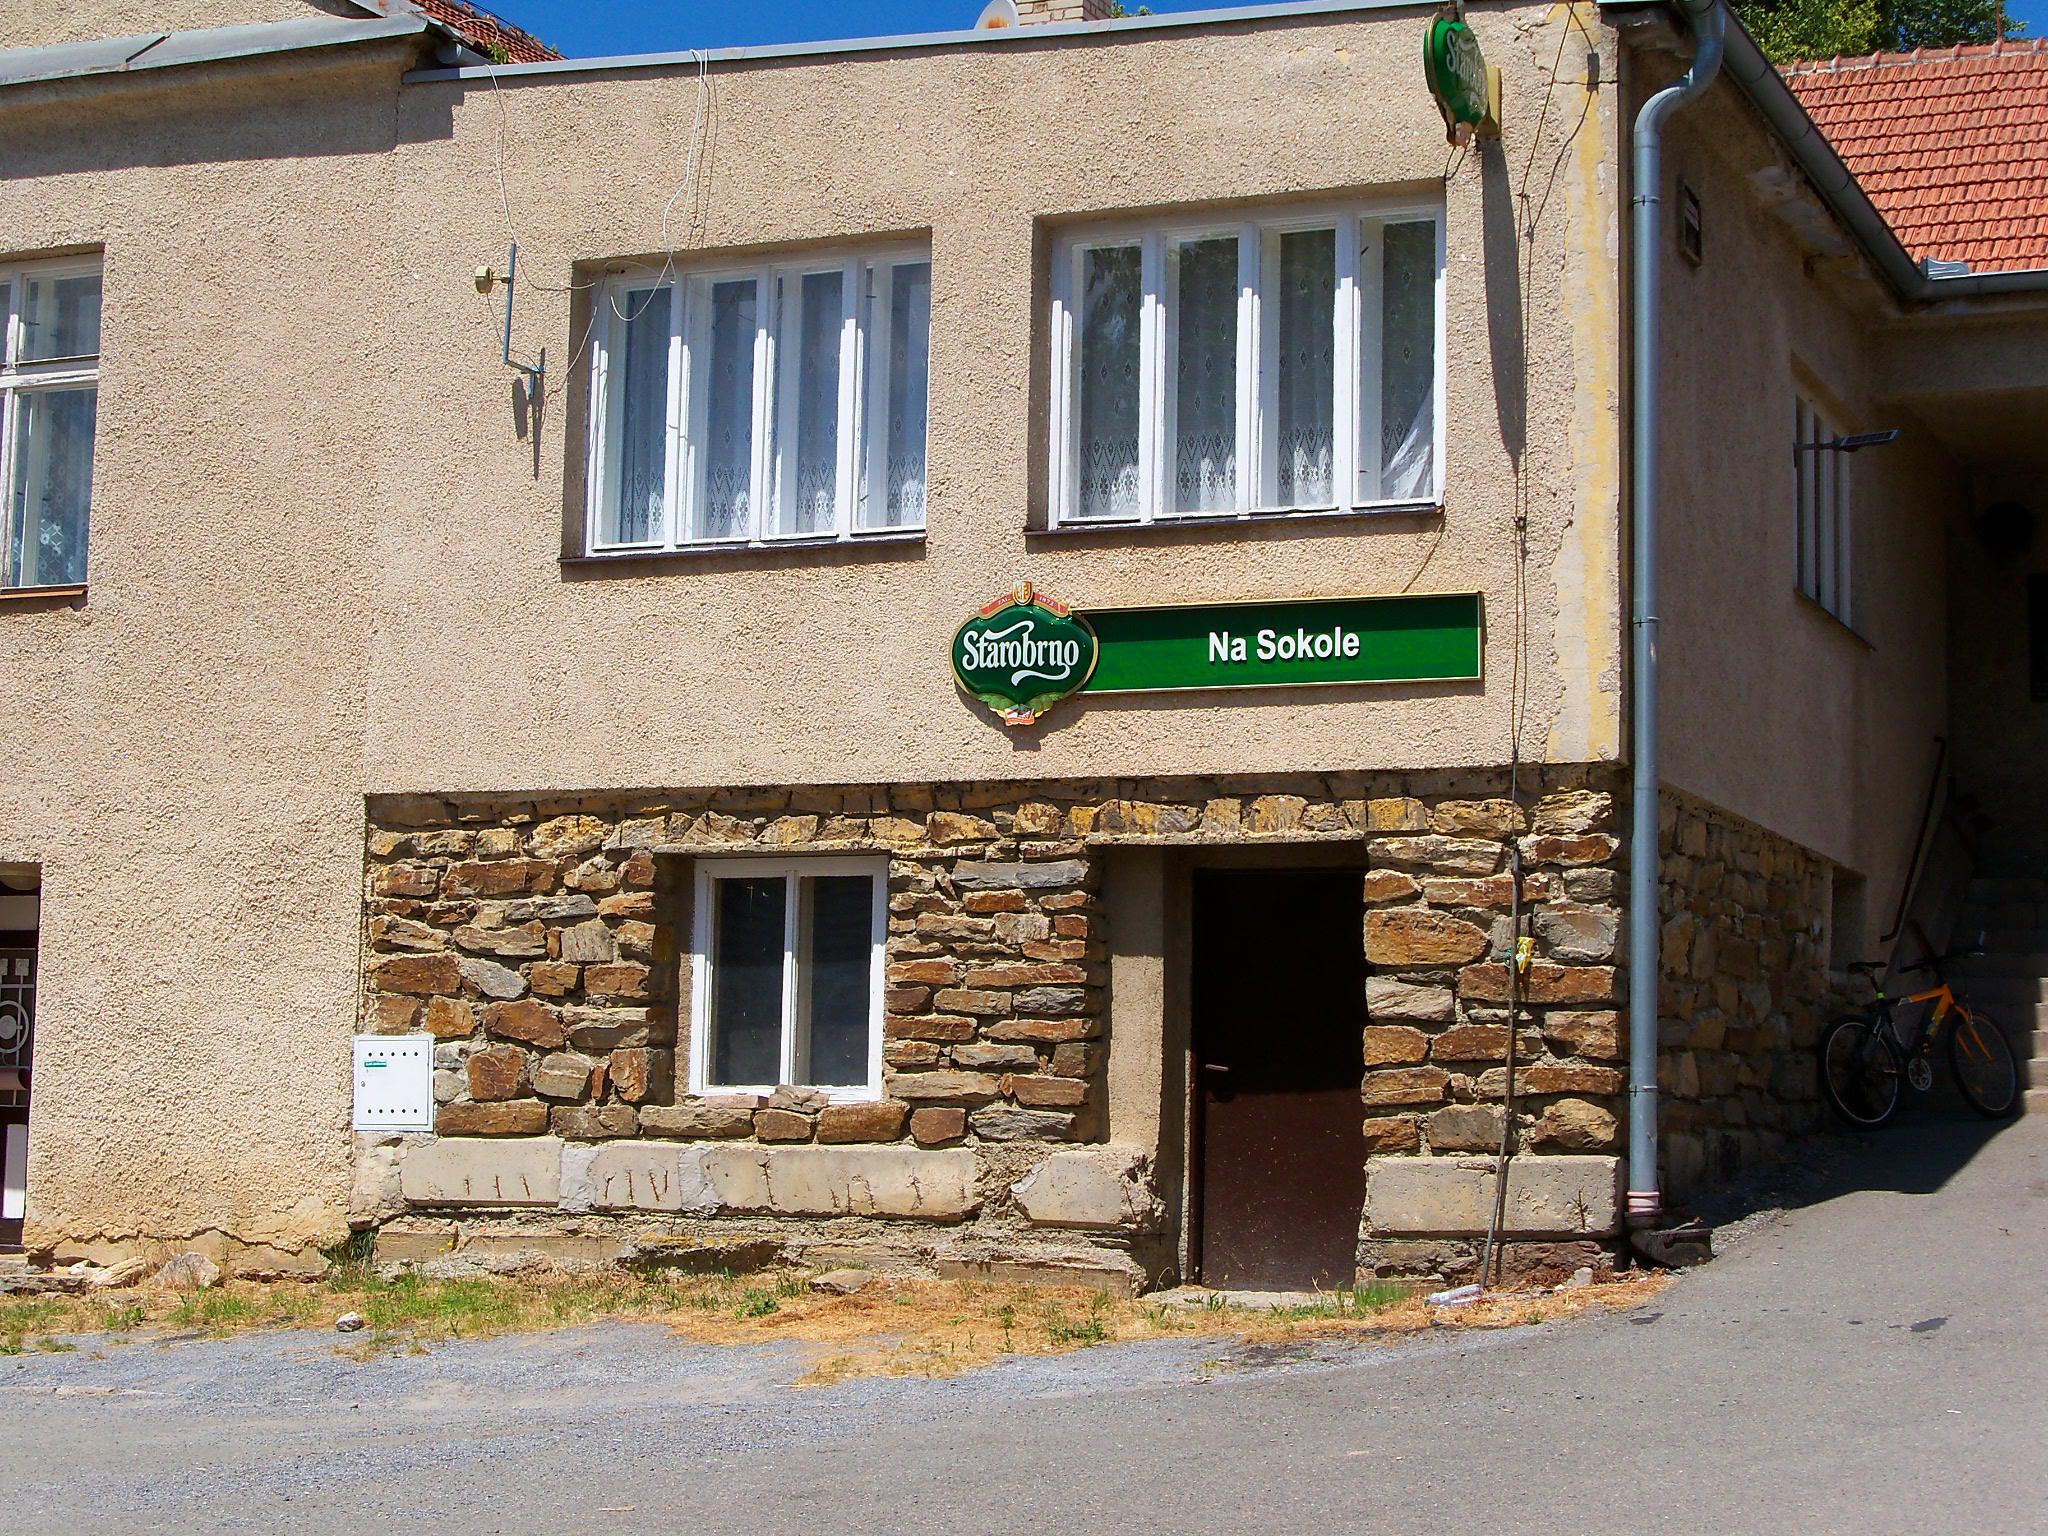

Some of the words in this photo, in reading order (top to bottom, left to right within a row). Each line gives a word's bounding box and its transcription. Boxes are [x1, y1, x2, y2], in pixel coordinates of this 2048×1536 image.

[962, 620, 1079, 686] Starobrno
[1209, 631, 1247, 662] Na
[1256, 626, 1360, 660] Sokole
